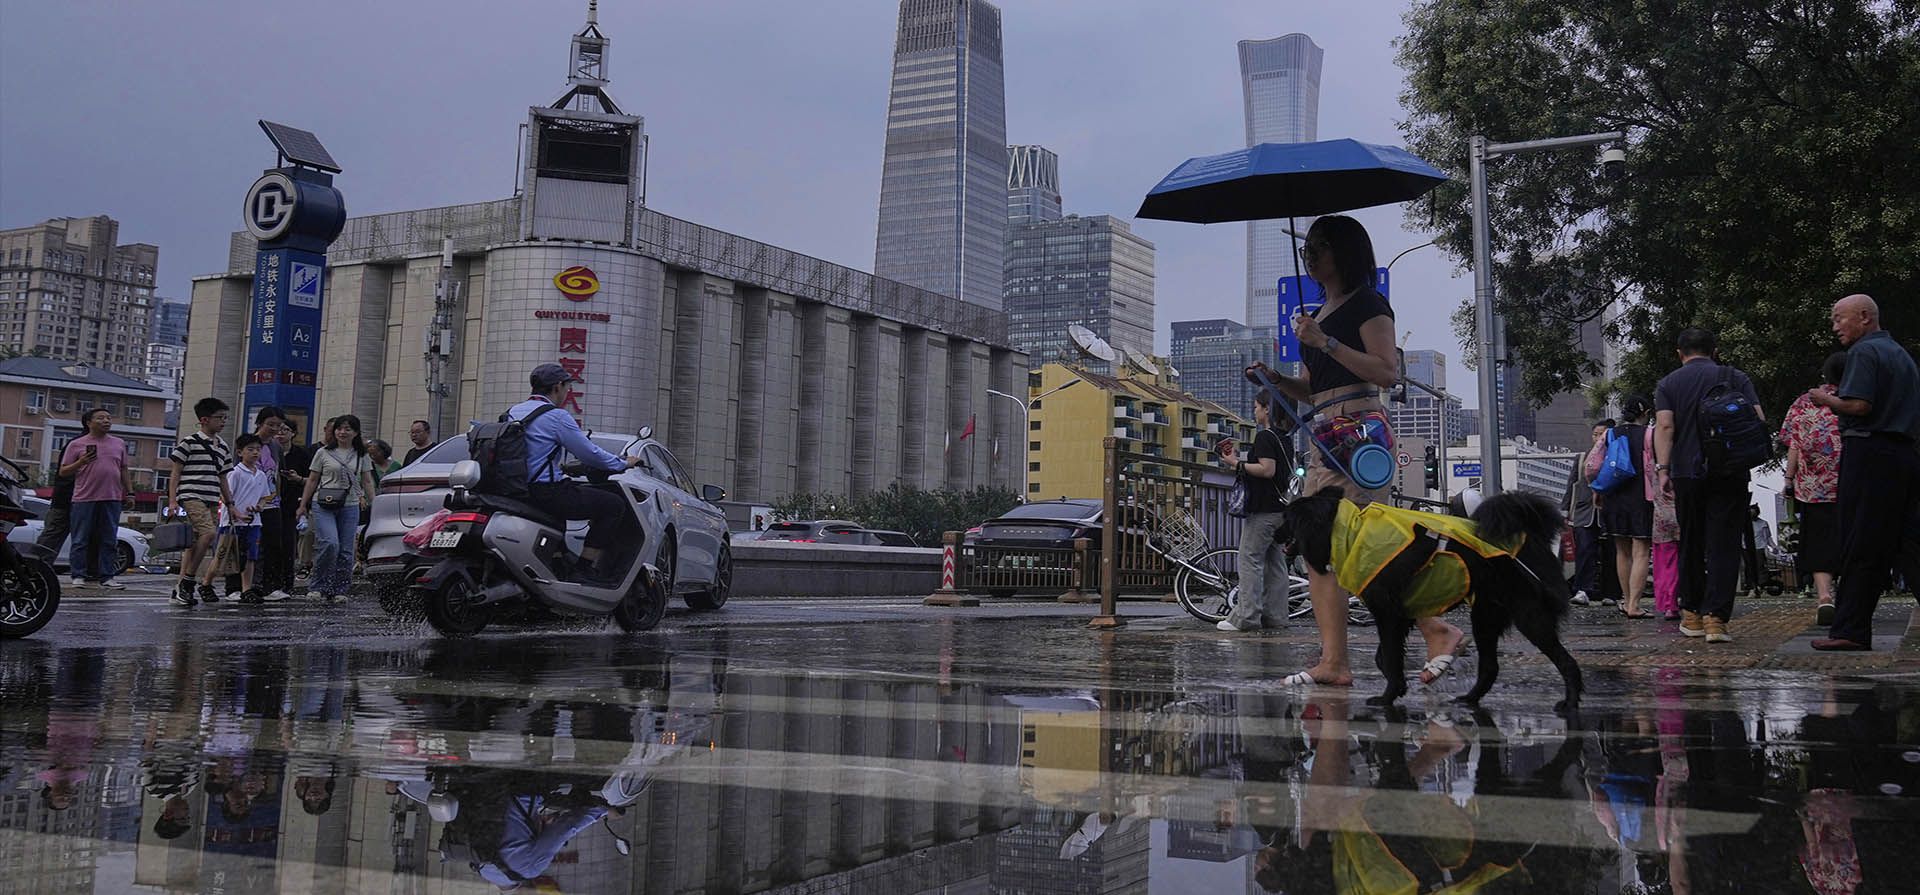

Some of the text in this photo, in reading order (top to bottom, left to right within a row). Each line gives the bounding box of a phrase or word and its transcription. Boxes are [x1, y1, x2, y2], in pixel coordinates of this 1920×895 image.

[262, 254, 280, 344] 地铁永安里站
[293, 328, 310, 343] A2
